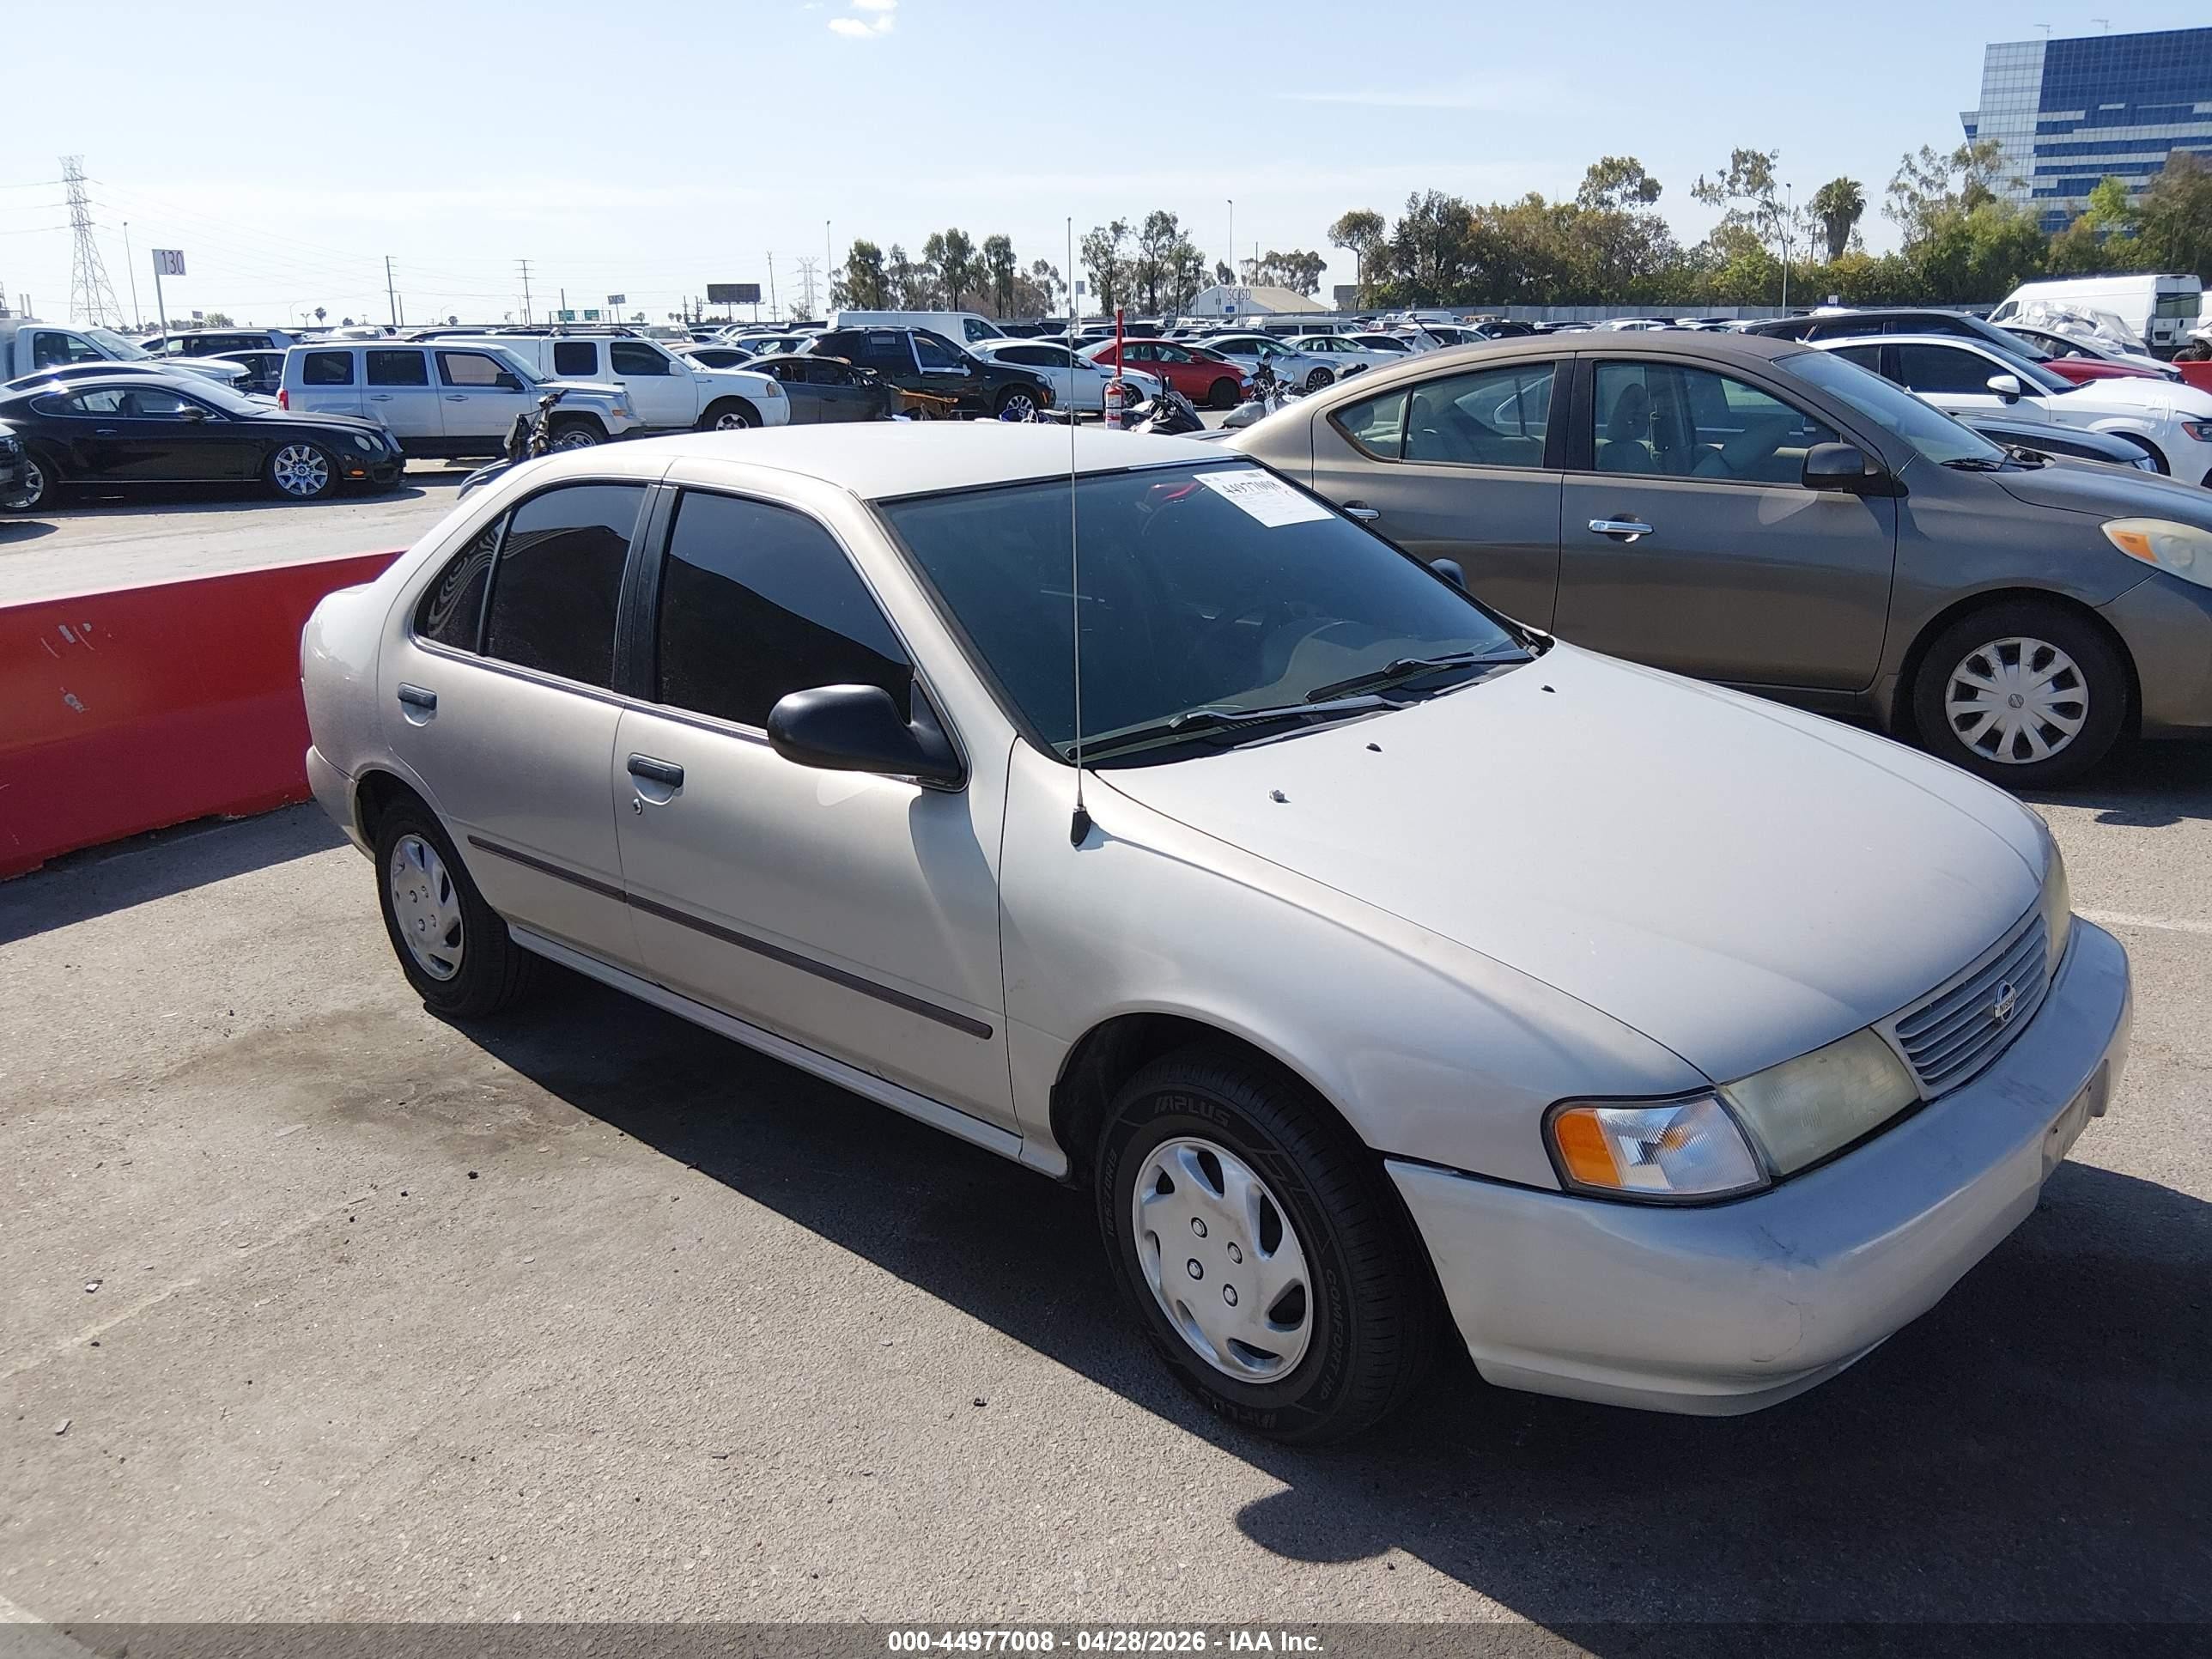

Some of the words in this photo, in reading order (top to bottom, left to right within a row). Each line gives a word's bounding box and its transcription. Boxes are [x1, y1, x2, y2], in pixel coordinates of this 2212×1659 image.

[161, 251, 185, 274] 130
[1999, 993, 2015, 1014] NISSAN
[1326, 1268, 1344, 1376] COMFORT
